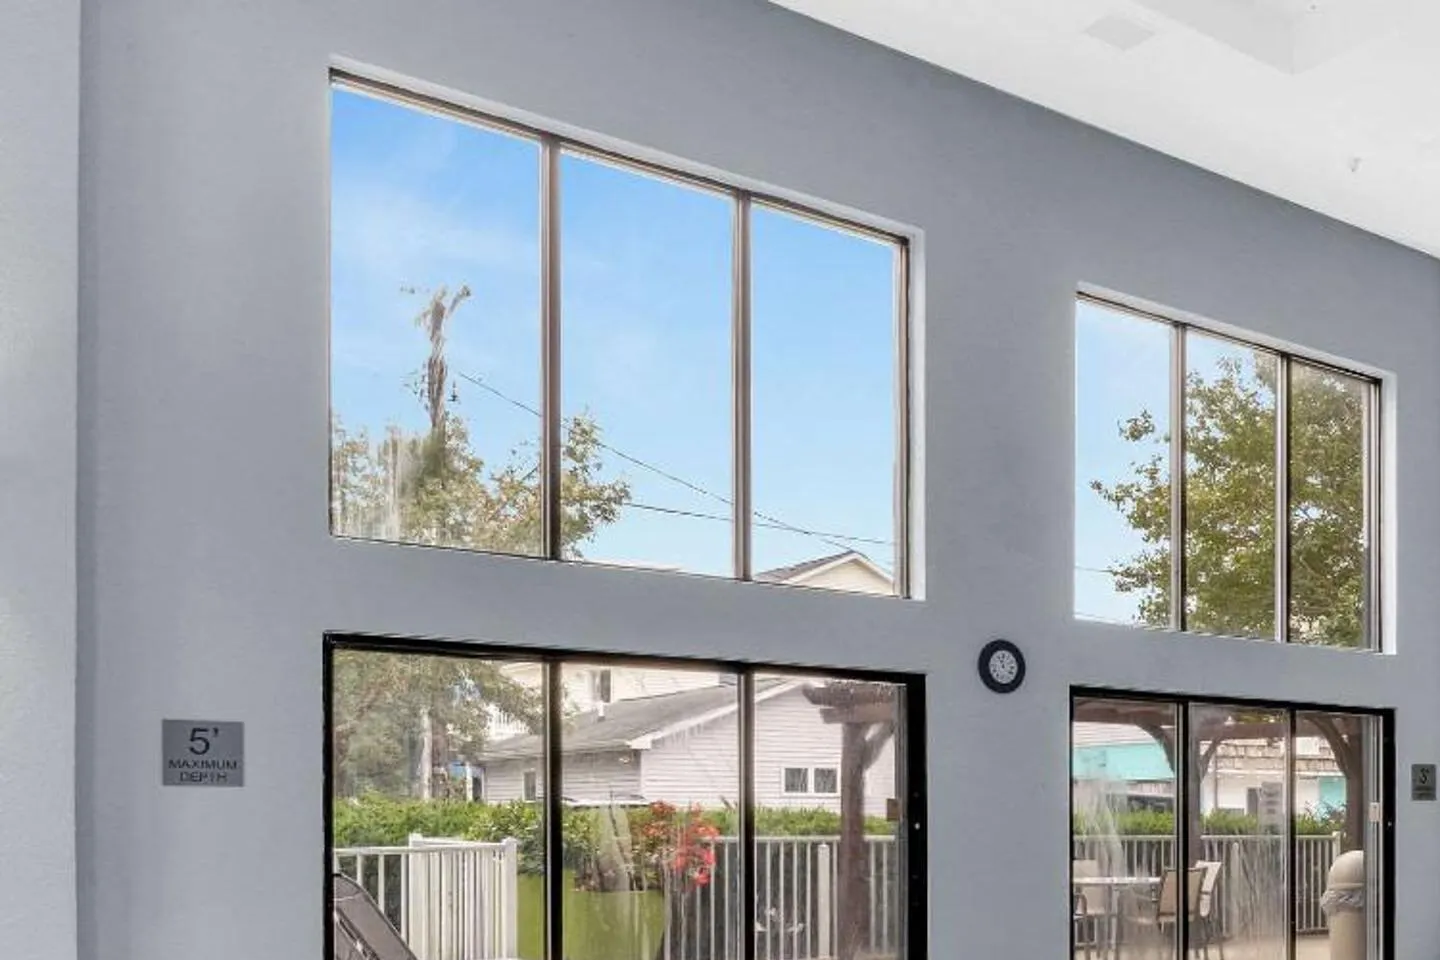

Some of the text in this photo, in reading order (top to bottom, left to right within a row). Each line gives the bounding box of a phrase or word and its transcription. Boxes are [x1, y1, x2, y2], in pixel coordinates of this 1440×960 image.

[189, 727, 219, 755] 5'
[168, 759, 237, 770] MAXIMUM
[180, 771, 228, 783] DEPTH
